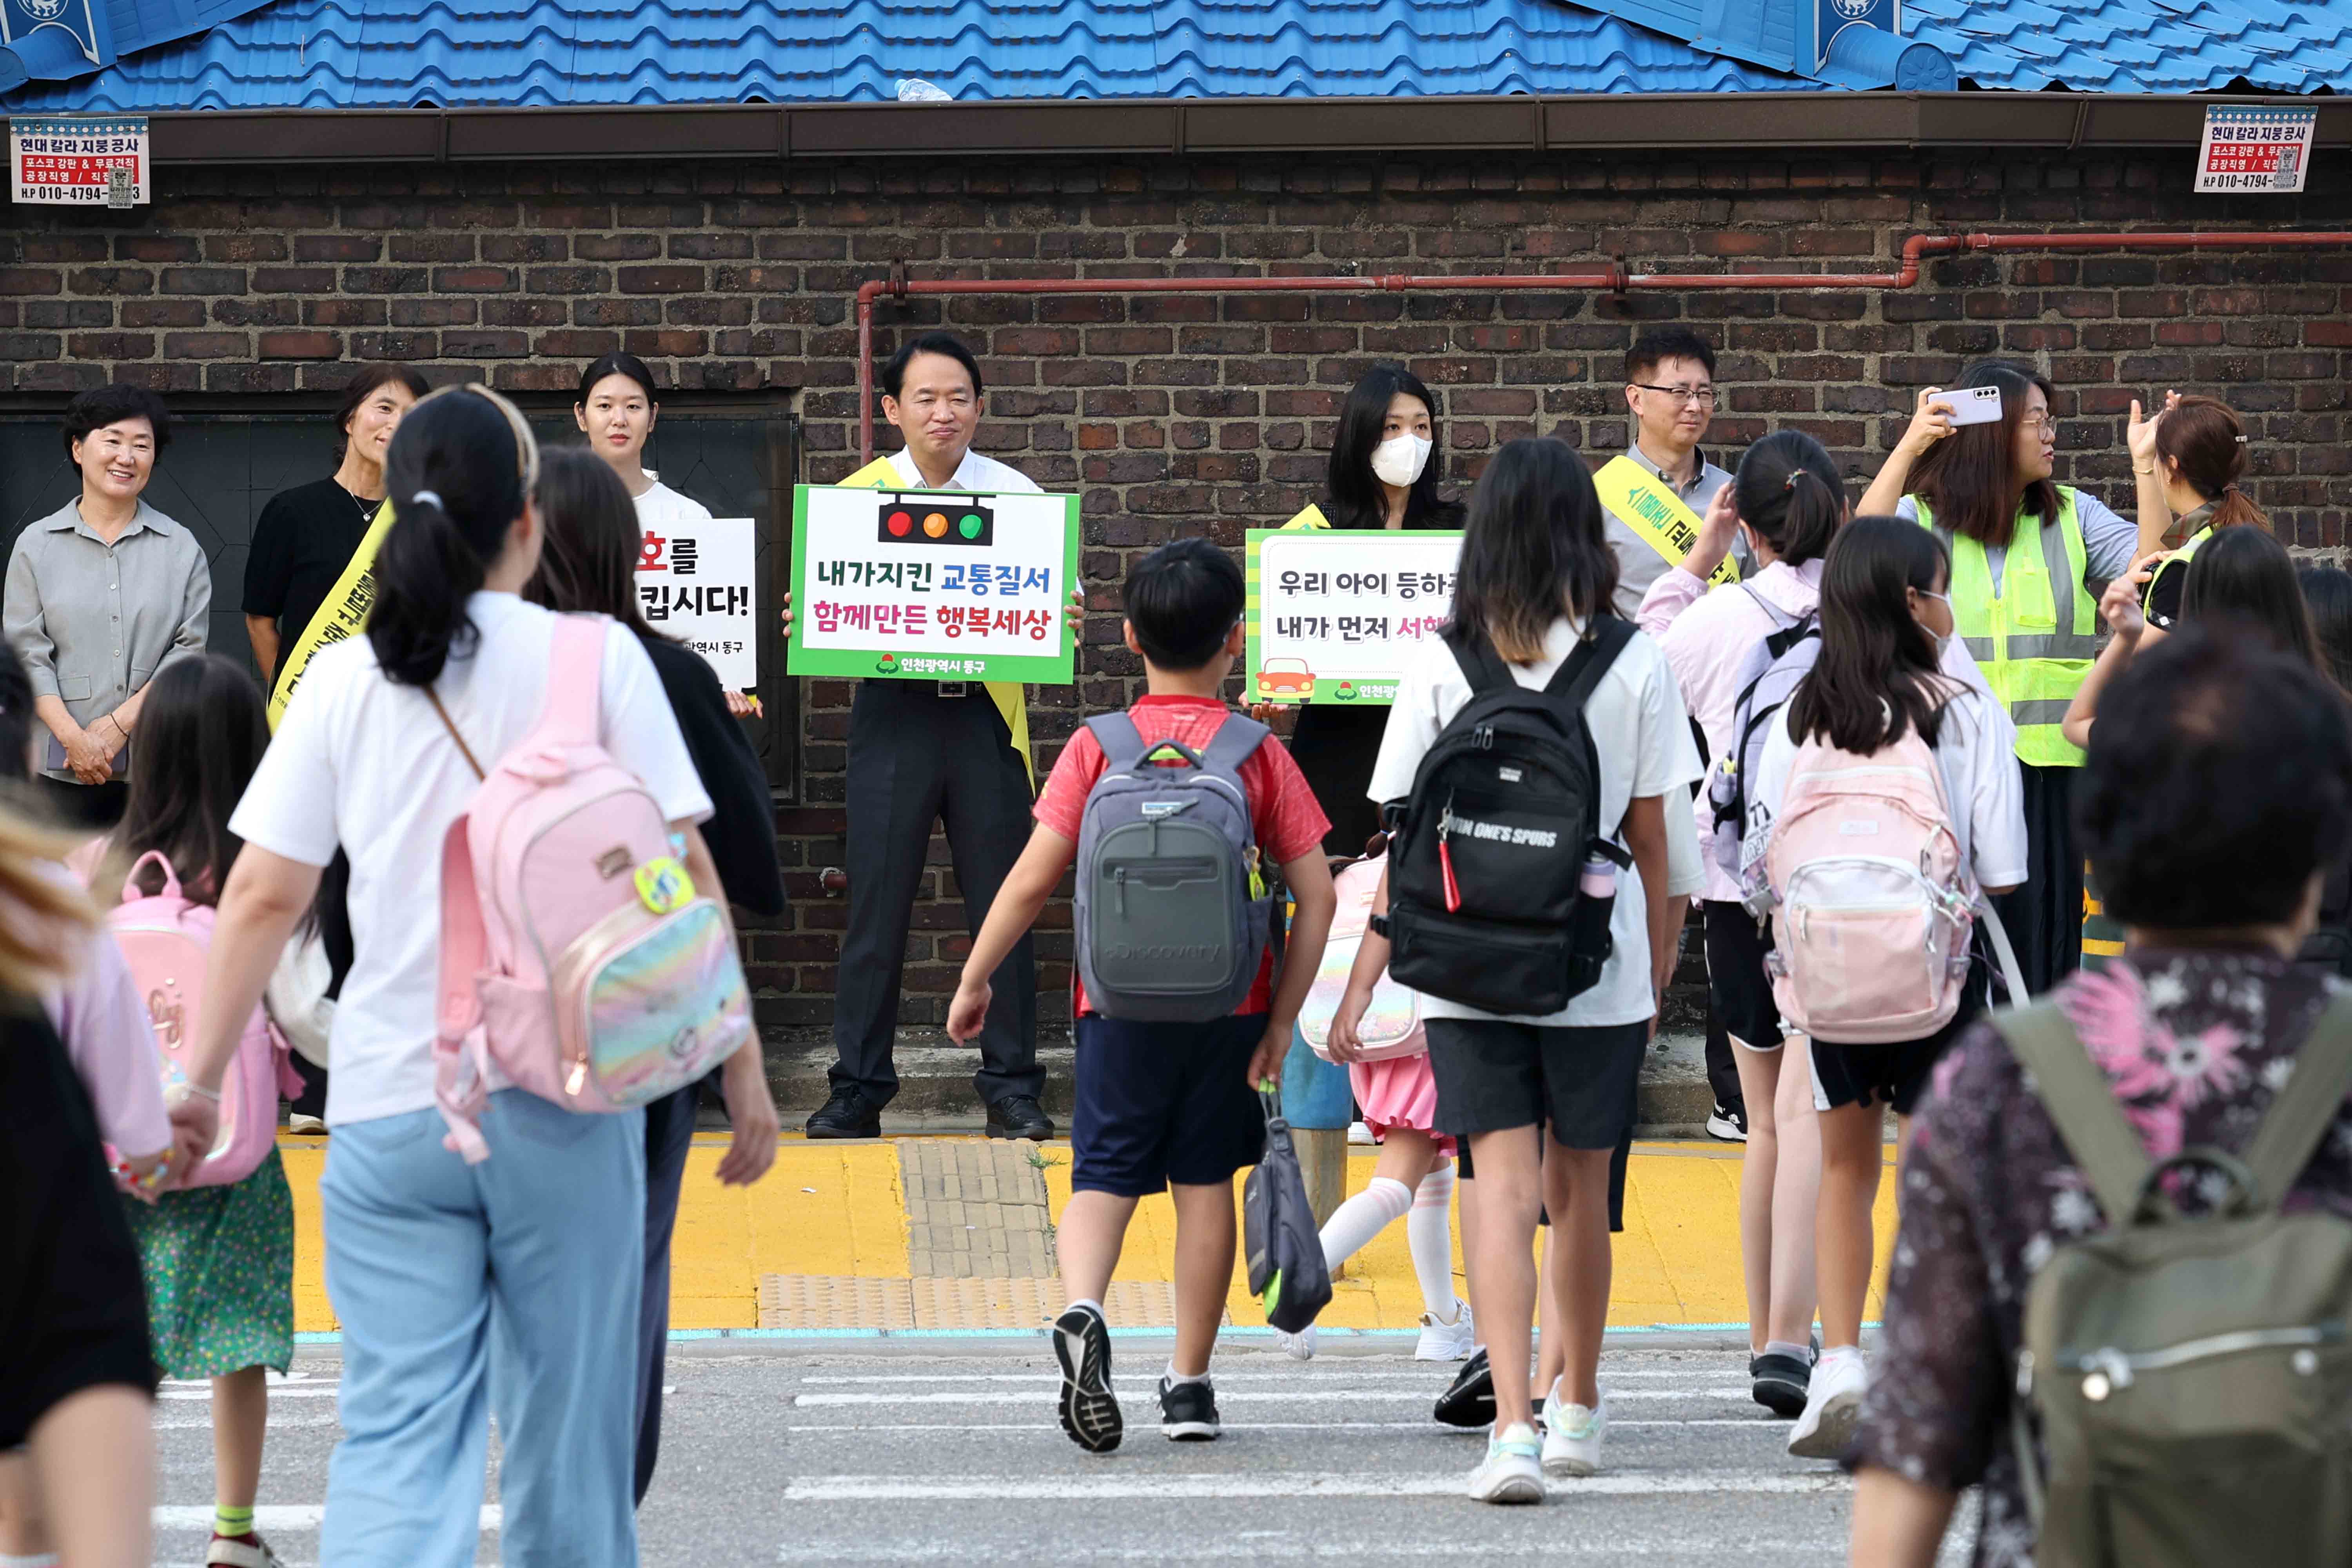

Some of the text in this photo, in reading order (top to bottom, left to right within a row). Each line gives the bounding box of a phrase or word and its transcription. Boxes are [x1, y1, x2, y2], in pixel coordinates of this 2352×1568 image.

[2212, 127, 2306, 140] 현대 칼라 지붕 공사
[20, 138, 139, 153] 현대 칼라 지붕 공사
[2212, 146, 2236, 156] 포스코
[2239, 146, 2254, 157] 강판
[2258, 147, 2263, 156] &
[25, 158, 55, 168] 포스코
[58, 158, 76, 169] 강판
[82, 159, 89, 169] &
[2210, 159, 2246, 170] 공장직영
[2251, 159, 2258, 170] /
[25, 171, 69, 182] 공장직영
[78, 172, 82, 183] /
[2203, 175, 2297, 187] H.P 010-4794-3
[22, 186, 140, 200] H.P 010-4794-3
[818, 561, 1050, 596] 내가지킨 교통질서
[1279, 571, 1327, 595] 우리
[1336, 573, 1387, 595] 아이
[813, 600, 1052, 641] 함께만든 행복세상
[1277, 616, 1330, 639] 내가
[1338, 616, 1388, 641] 먼저
[722, 641, 743, 654] 동구
[901, 658, 985, 674] 인천광역시 동구
[1474, 822, 1513, 842] ONE'S
[1512, 828, 1557, 848] SPURS
